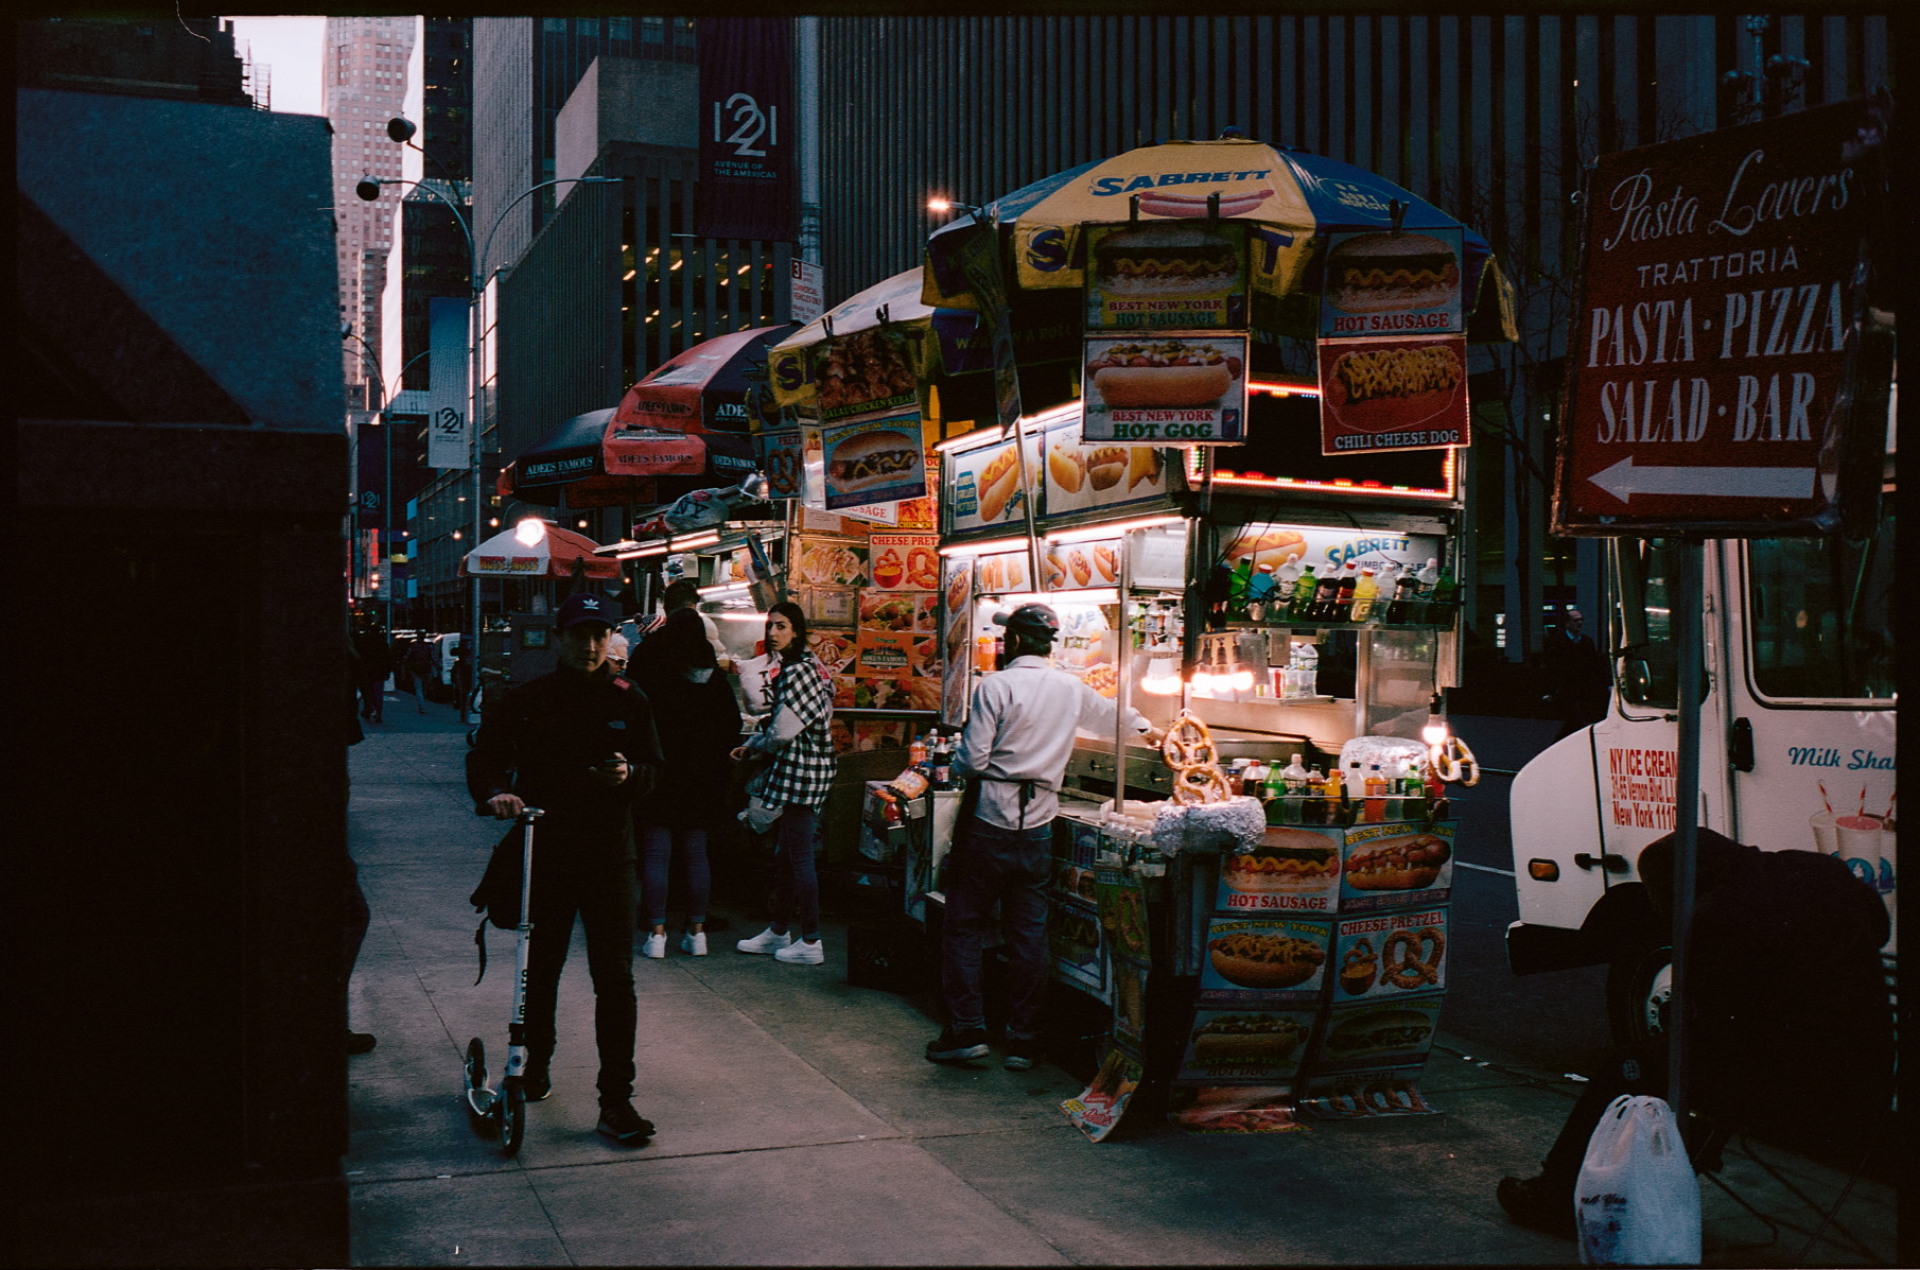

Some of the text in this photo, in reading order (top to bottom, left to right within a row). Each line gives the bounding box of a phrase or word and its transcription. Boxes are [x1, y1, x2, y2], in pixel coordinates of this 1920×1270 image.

[713, 91, 778, 158] 1221
[713, 160, 763, 170] AVENUE OF
[713, 168, 778, 179] THE AMERICAS
[1089, 169, 1272, 196] SABRETT
[1602, 149, 1854, 251] Pasta Lovers
[793, 261, 800, 278] 3
[1637, 244, 1800, 288] TRATTORIA
[1109, 299, 1223, 311] BEST NEW YORK
[1116, 312, 1217, 325] HOT SAUSAGE
[1333, 313, 1450, 332] HOT SAUSAGE
[1586, 280, 1846, 368] PASTA PIZZA
[714, 403, 749, 417] ADE
[1112, 409, 1214, 421] BEST NEW YORK
[1596, 372, 1817, 445] SALAD BAR
[435, 407, 464, 434] 1221
[1112, 423, 1213, 439] HOT GOG
[1334, 429, 1460, 449] CHILI CHEESE DOG
[871, 536, 939, 546] CHEESE PRET
[1325, 537, 1409, 571] SABRETT
[1609, 748, 1624, 775] NY
[1625, 749, 1642, 776] ICE
[1788, 747, 1898, 770] Milk Sha
[1612, 801, 1632, 826] New
[1632, 802, 1655, 828] York
[1345, 827, 1381, 845] BEST
[1382, 823, 1414, 836] NEW
[1226, 894, 1259, 908] HOT
[1260, 895, 1328, 910] SAUSAGE
[1211, 920, 1329, 936] BEST NEW YORK
[1340, 911, 1445, 936] CHEESE PRETZEL
